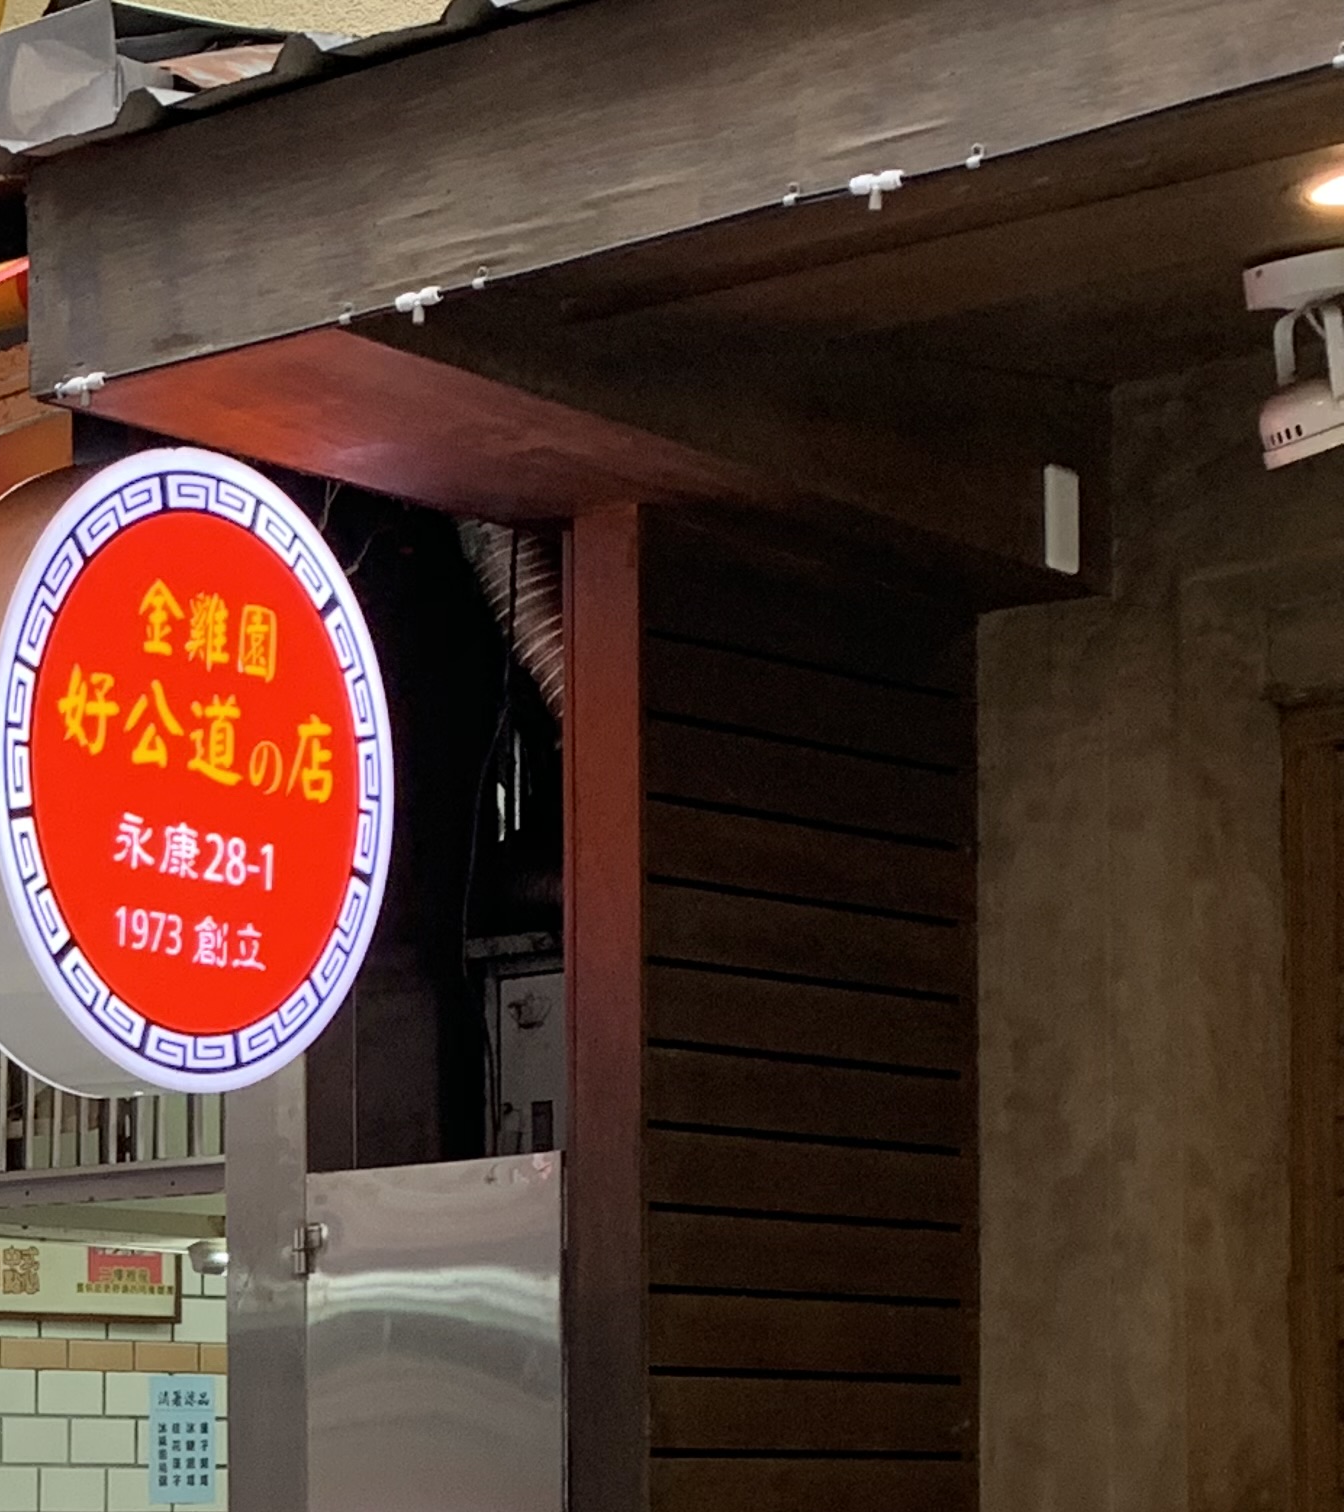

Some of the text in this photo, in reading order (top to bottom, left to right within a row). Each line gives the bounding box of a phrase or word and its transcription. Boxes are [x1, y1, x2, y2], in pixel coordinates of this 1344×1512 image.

[137, 578, 278, 684] 金雞園
[57, 663, 335, 804] 好公道の店
[113, 905, 268, 973] 1973 創立
